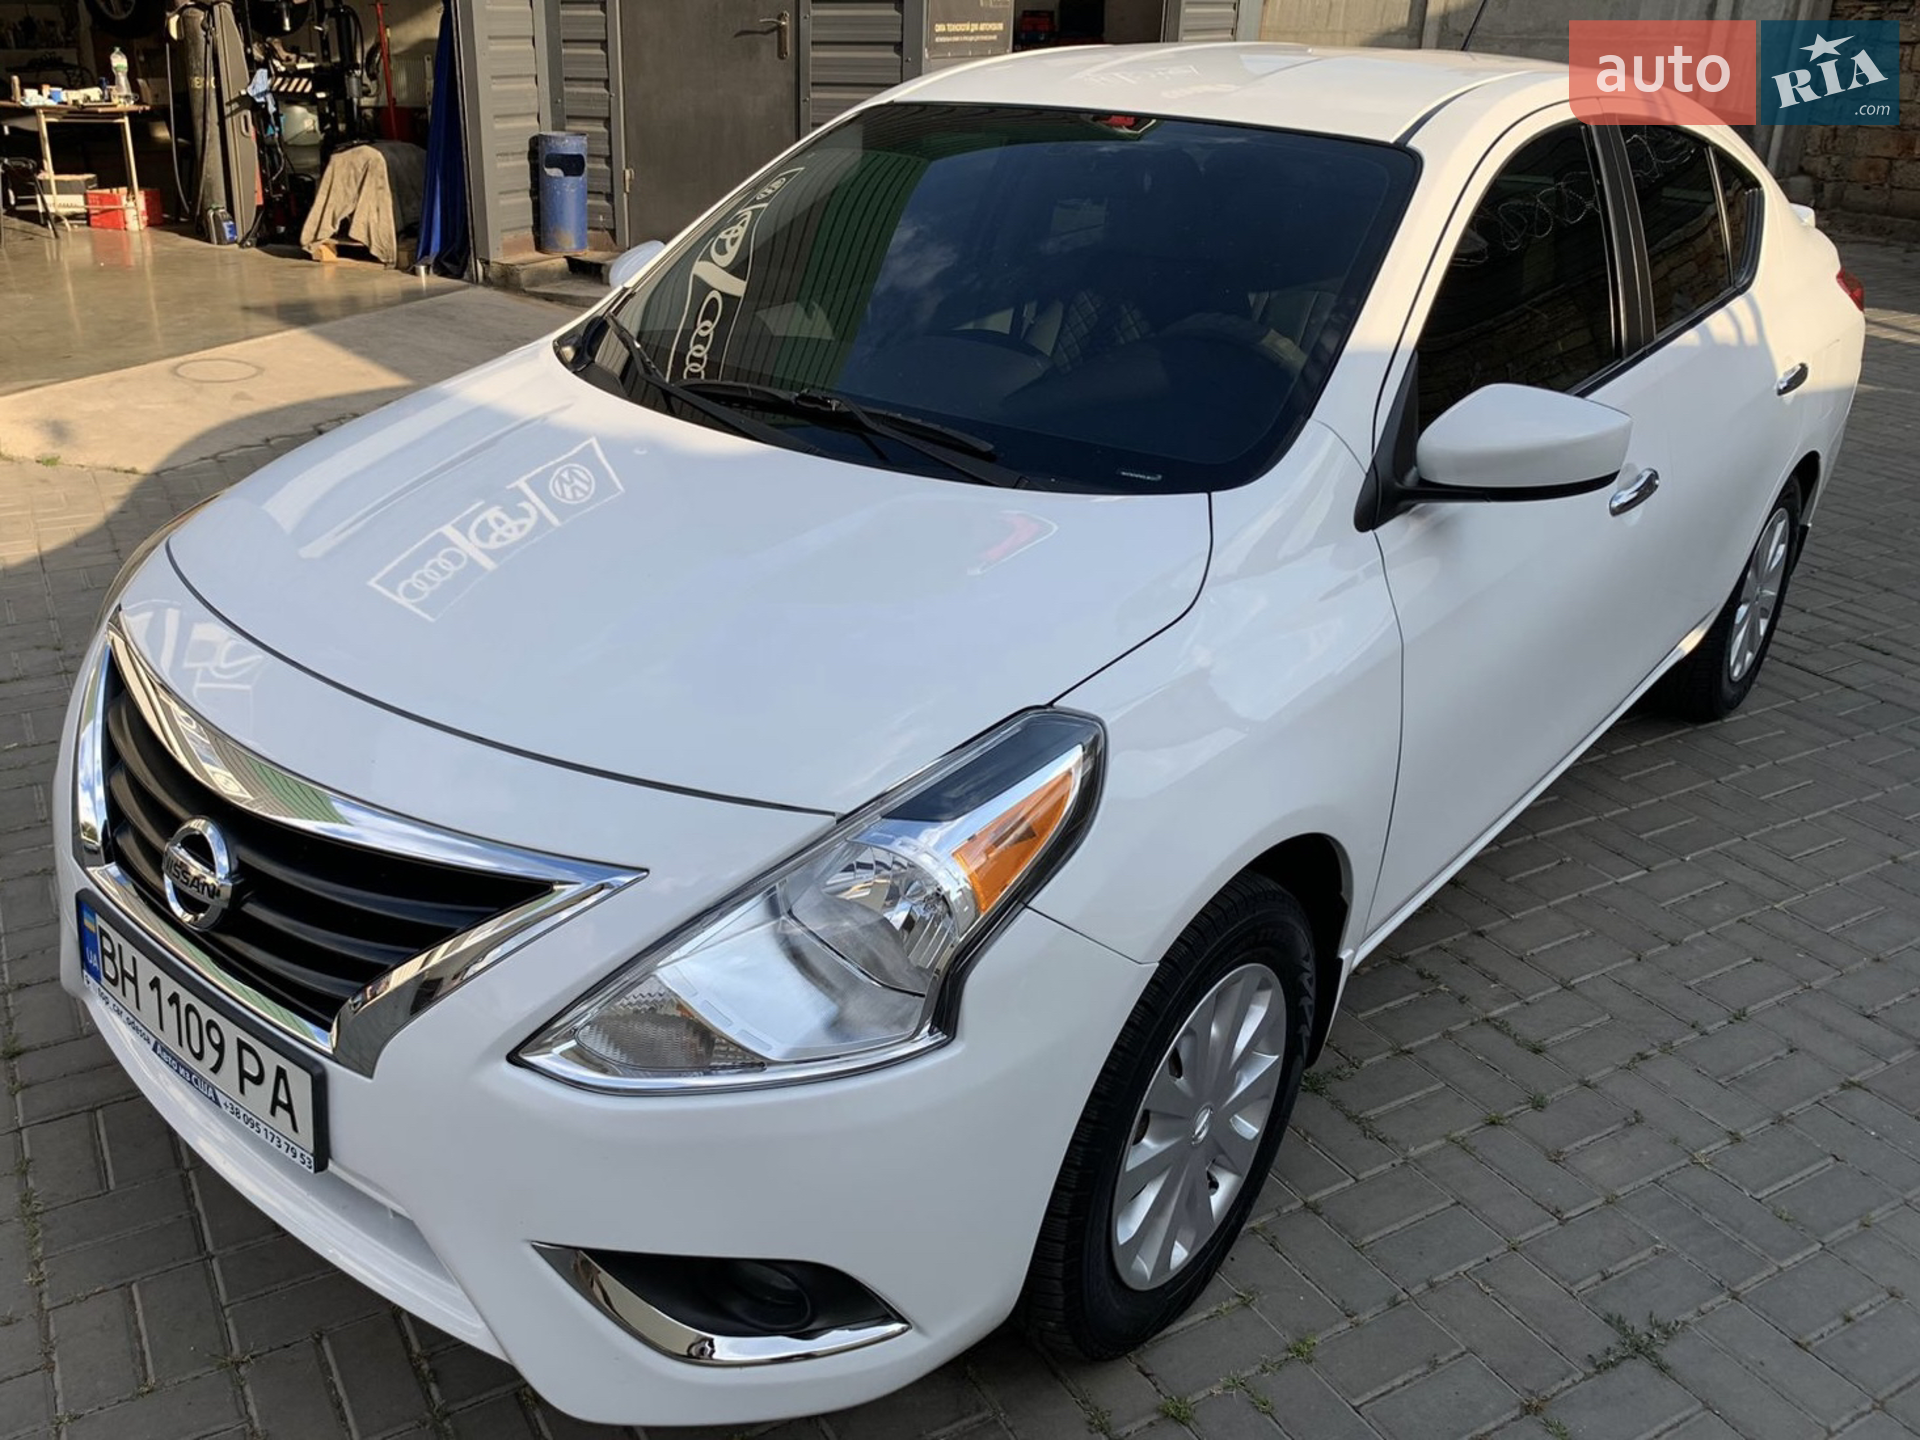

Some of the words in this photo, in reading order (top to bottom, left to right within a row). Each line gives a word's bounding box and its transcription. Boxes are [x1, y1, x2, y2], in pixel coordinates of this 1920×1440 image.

[165, 857, 218, 899] NISSAN
[86, 946, 100, 972] UA
[149, 975, 225, 1075] 1109
[223, 1102, 241, 1120] +38
[243, 1113, 261, 1135] 095
[263, 1127, 282, 1149] 173
[284, 1141, 297, 1159] 79
[300, 1152, 313, 1170] 53
